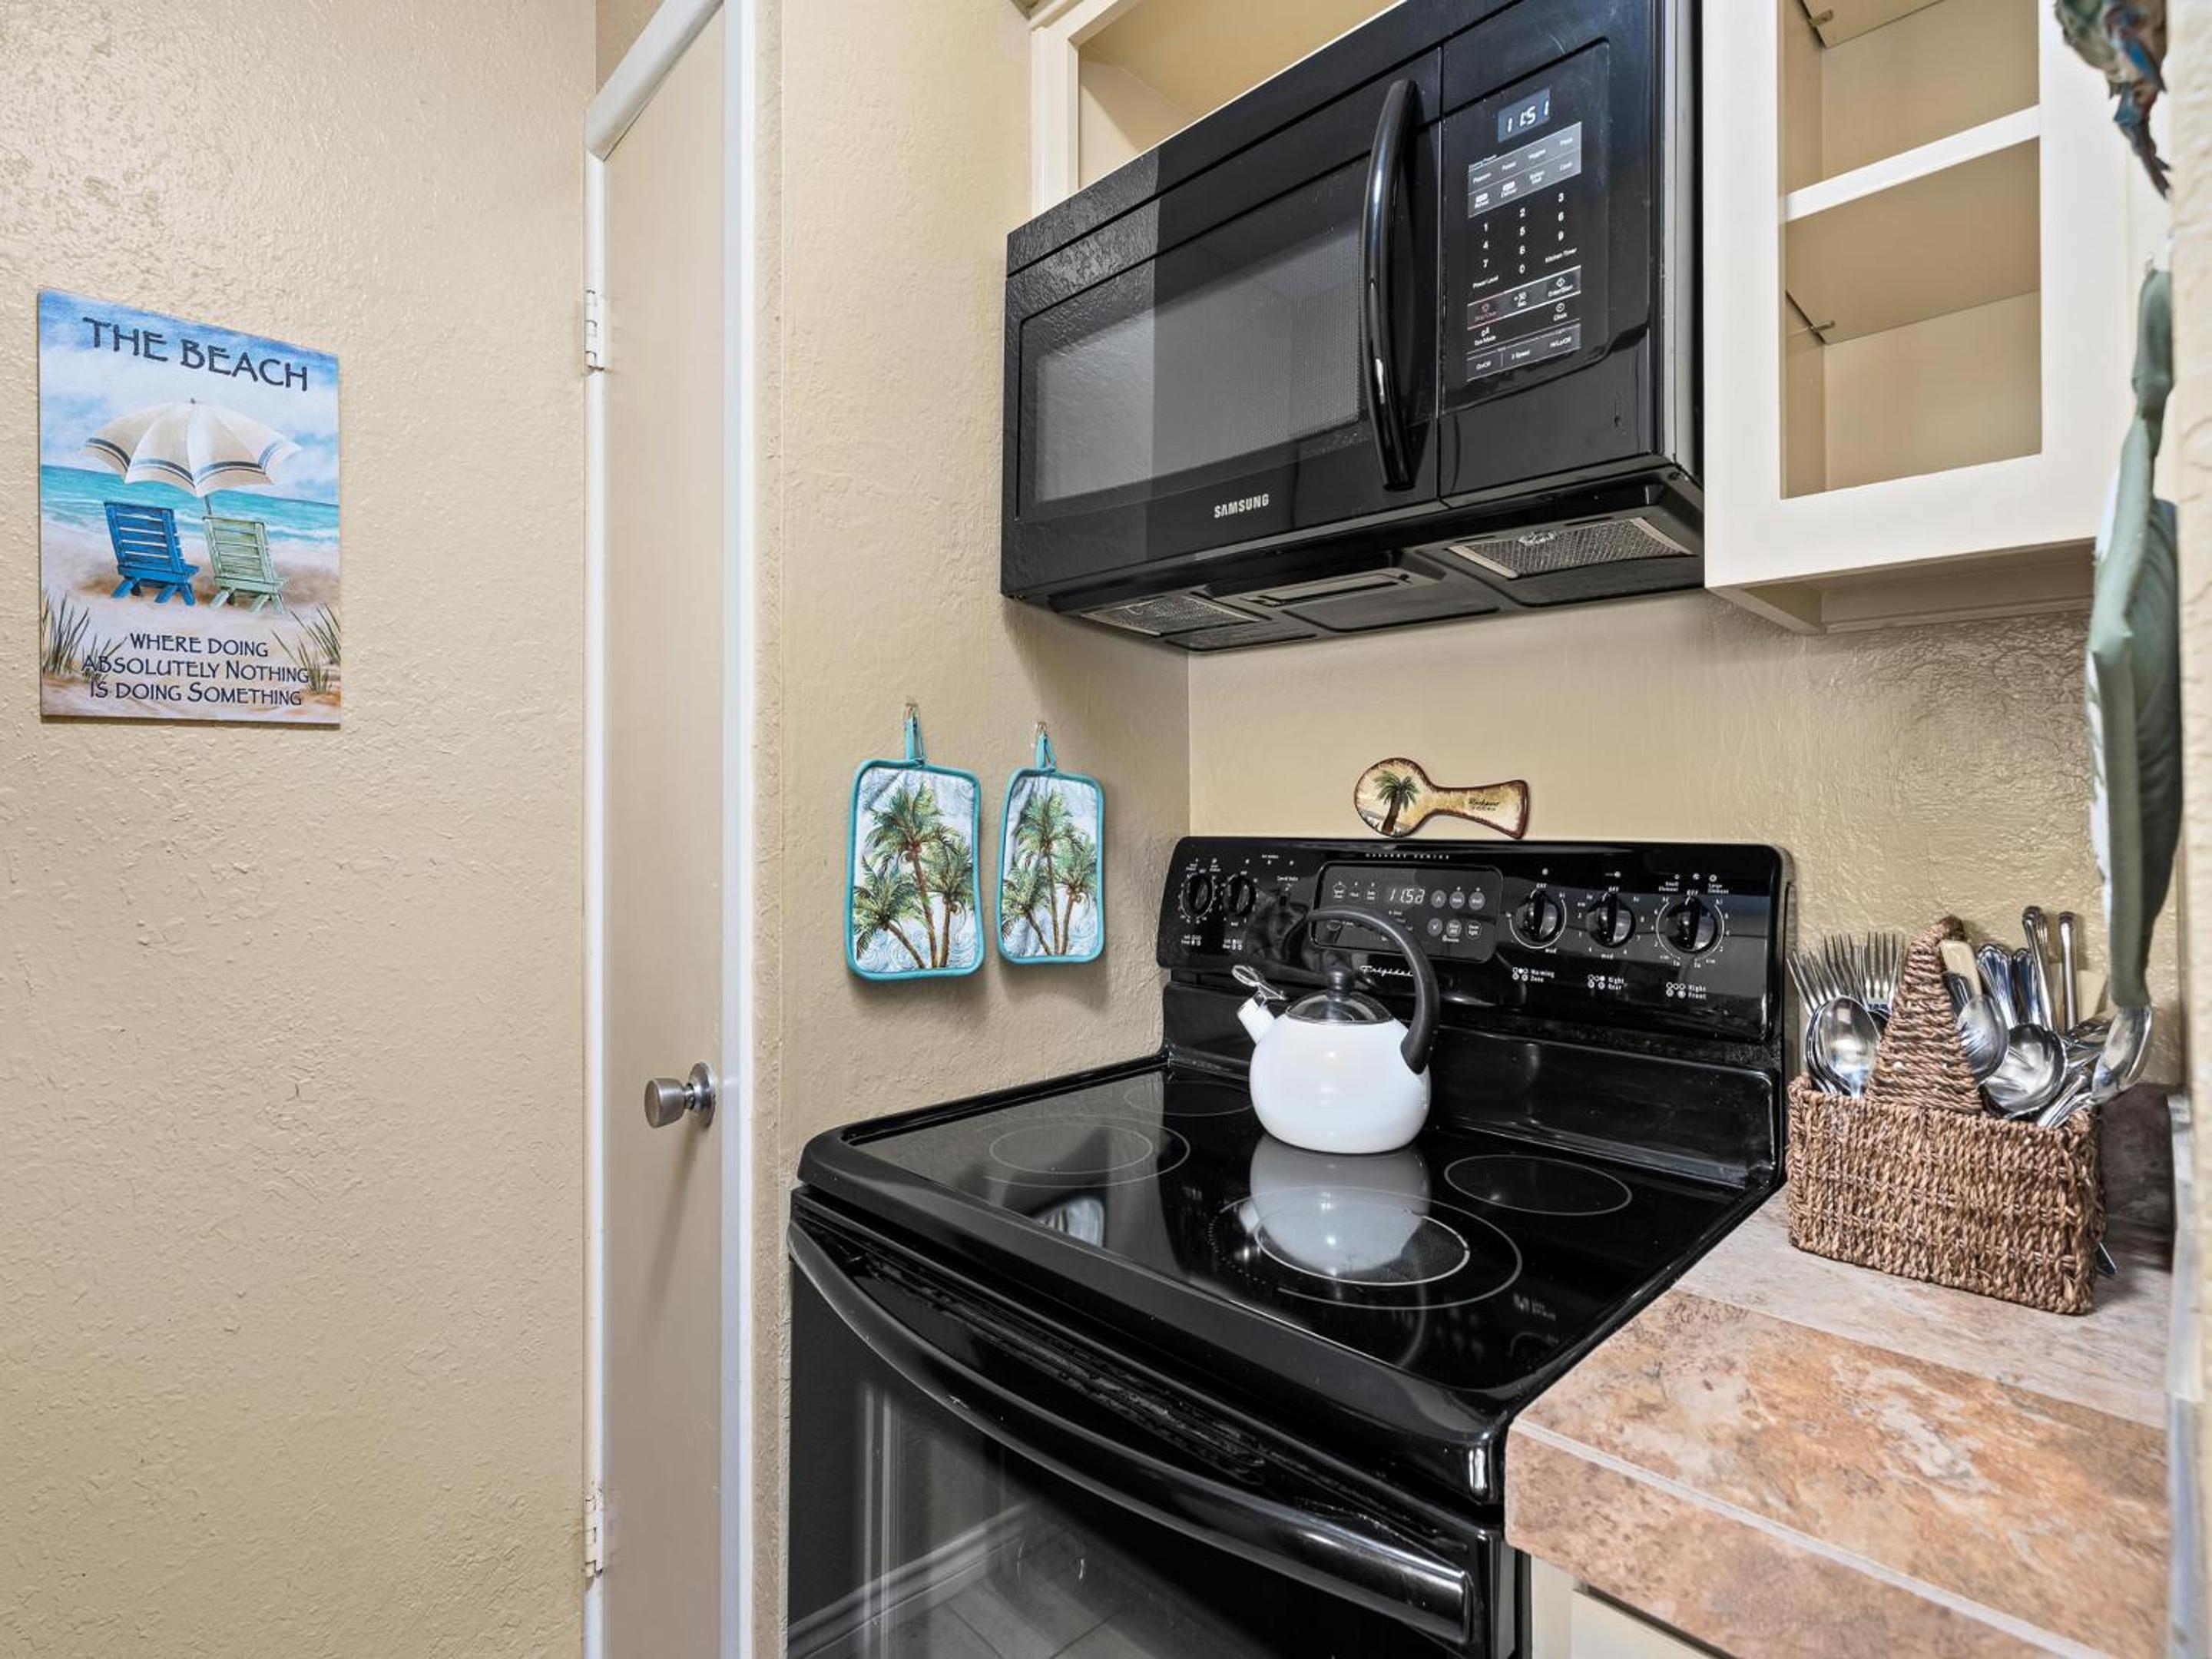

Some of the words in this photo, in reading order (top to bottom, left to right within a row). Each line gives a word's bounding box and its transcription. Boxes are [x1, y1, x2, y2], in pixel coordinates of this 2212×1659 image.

[82, 316, 168, 363] THE
[180, 338, 309, 392] BEACH
[1214, 493, 1270, 518] SAMSUNG
[130, 632, 201, 654] WHERE
[208, 637, 269, 657] DOING
[81, 654, 220, 678] ABSOLUTELY
[226, 661, 309, 684] NOTHING
[90, 680, 109, 698] IS
[115, 682, 182, 701] DOING
[187, 682, 303, 706] SOMETHING
